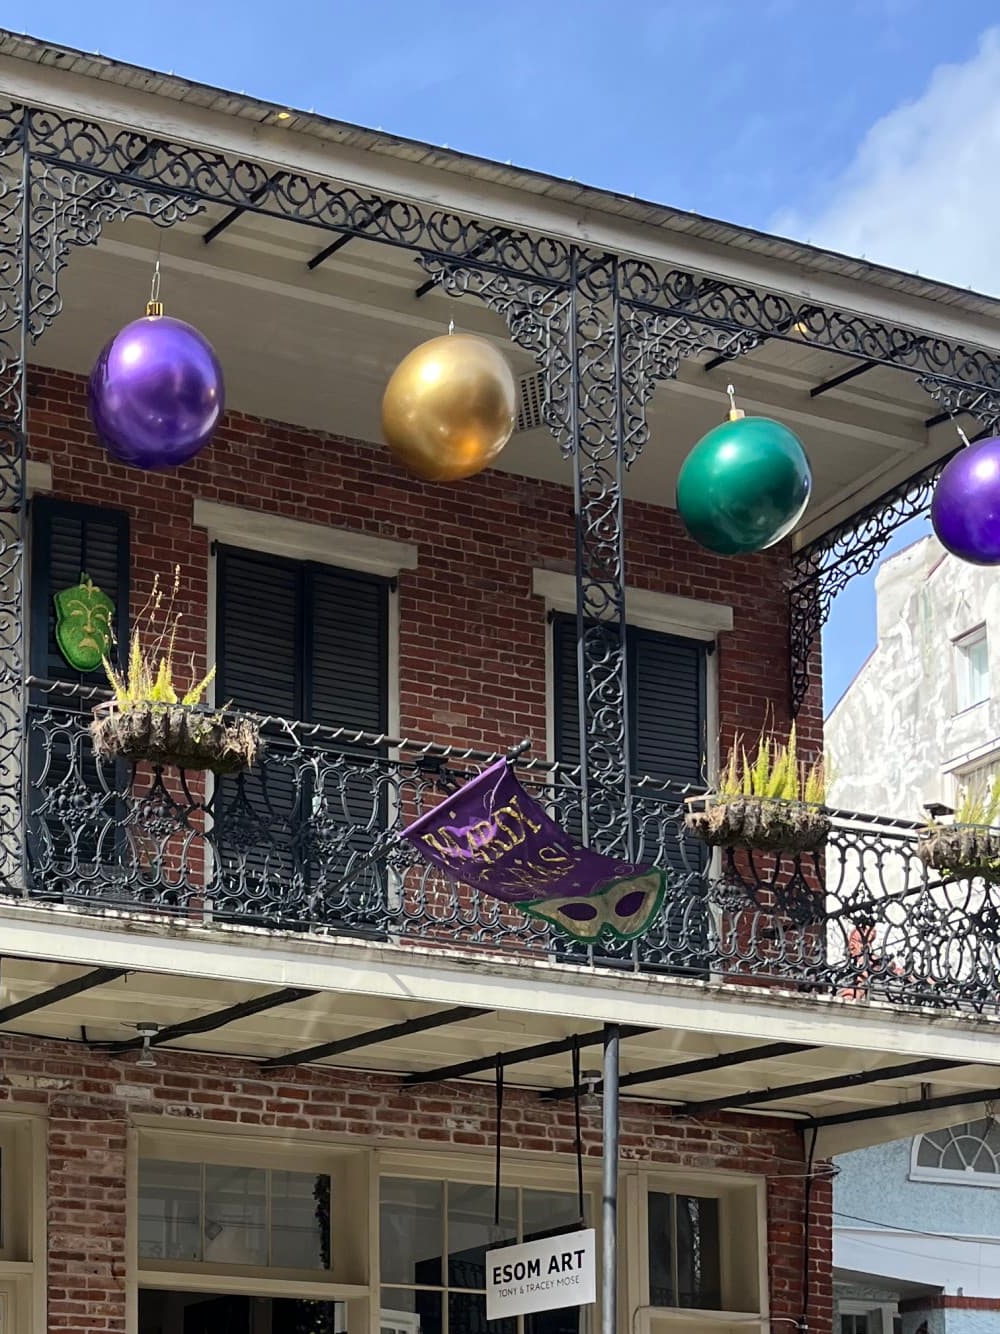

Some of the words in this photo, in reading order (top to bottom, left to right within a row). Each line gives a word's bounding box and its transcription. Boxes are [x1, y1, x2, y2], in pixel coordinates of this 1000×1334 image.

[421, 795, 542, 870] MARDI
[493, 1258, 540, 1285] ESOM
[547, 1249, 585, 1274] ART
[499, 1287, 517, 1297] TONY
[520, 1285, 524, 1294] &
[526, 1280, 554, 1292] TRACEY
[557, 1275, 580, 1287] MOSE
